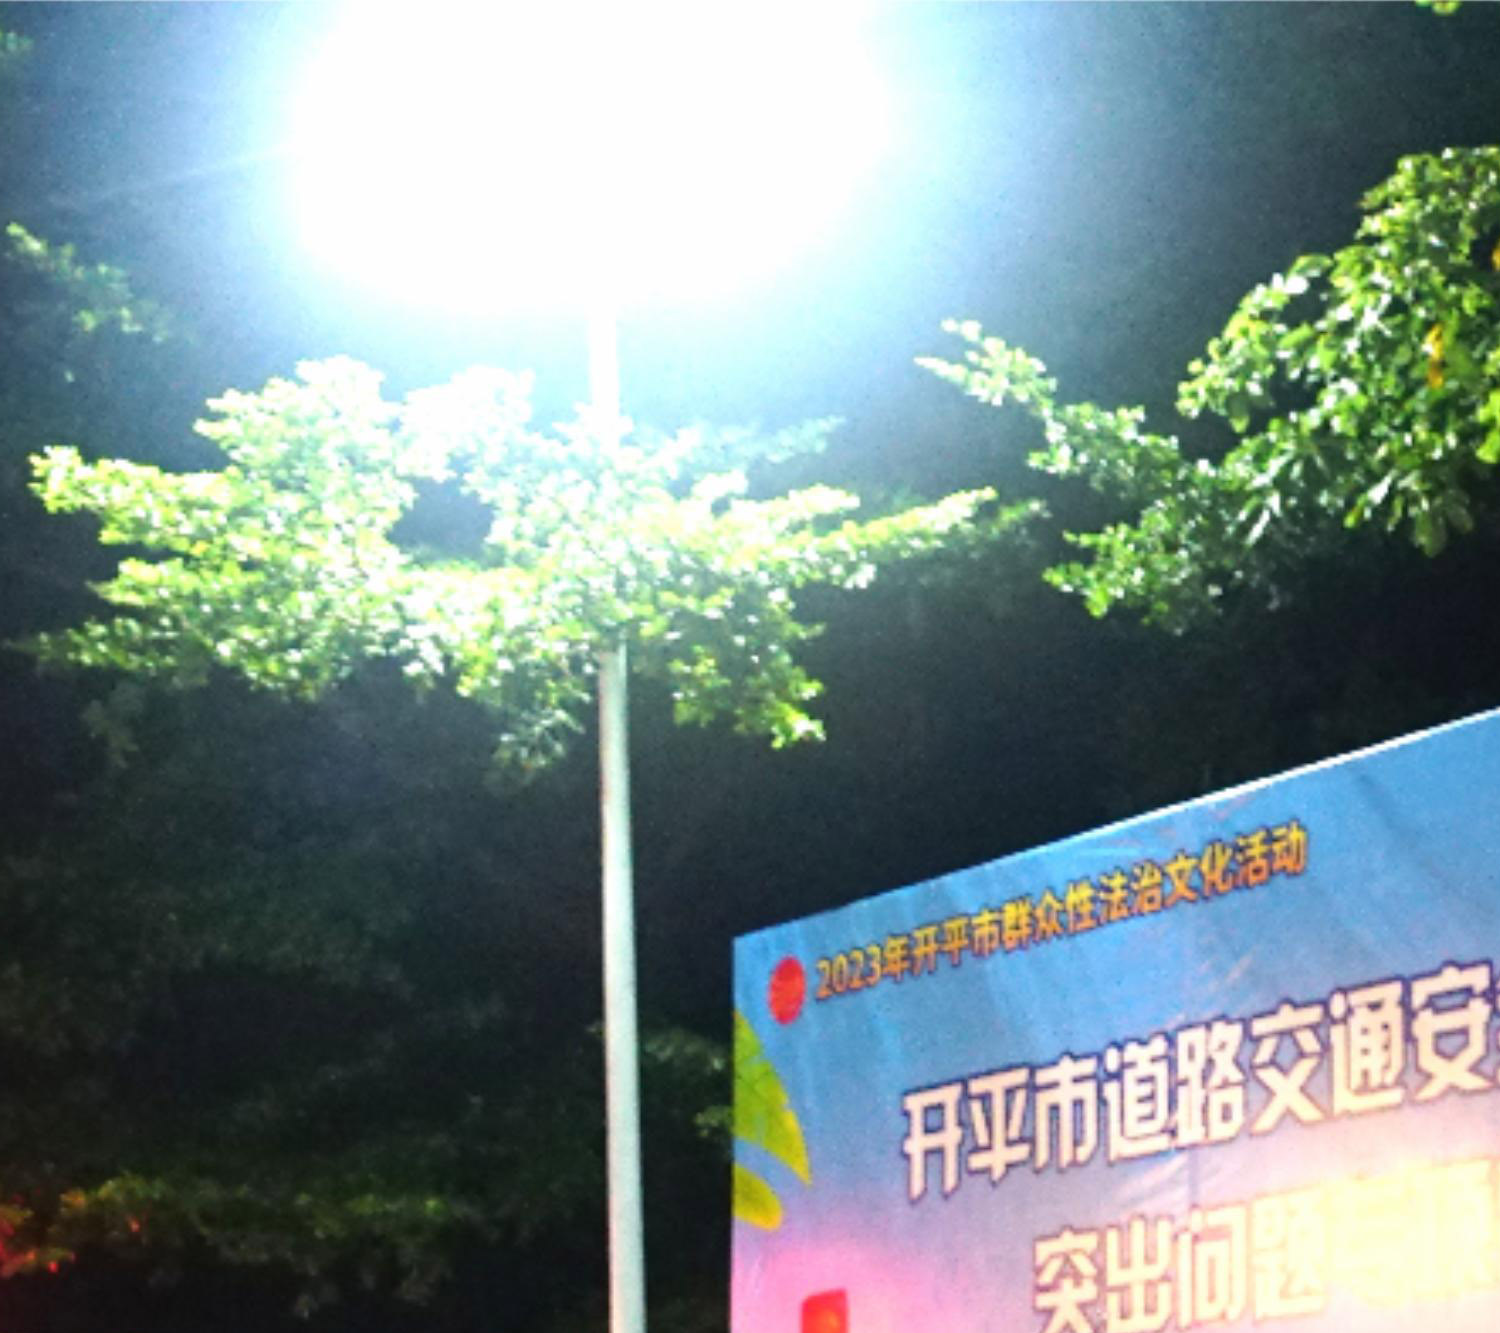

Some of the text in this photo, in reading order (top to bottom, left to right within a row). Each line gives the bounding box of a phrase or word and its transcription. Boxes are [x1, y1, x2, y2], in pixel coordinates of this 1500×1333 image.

[815, 821, 1308, 1001] 2023年开平市群众性法治文化活动
